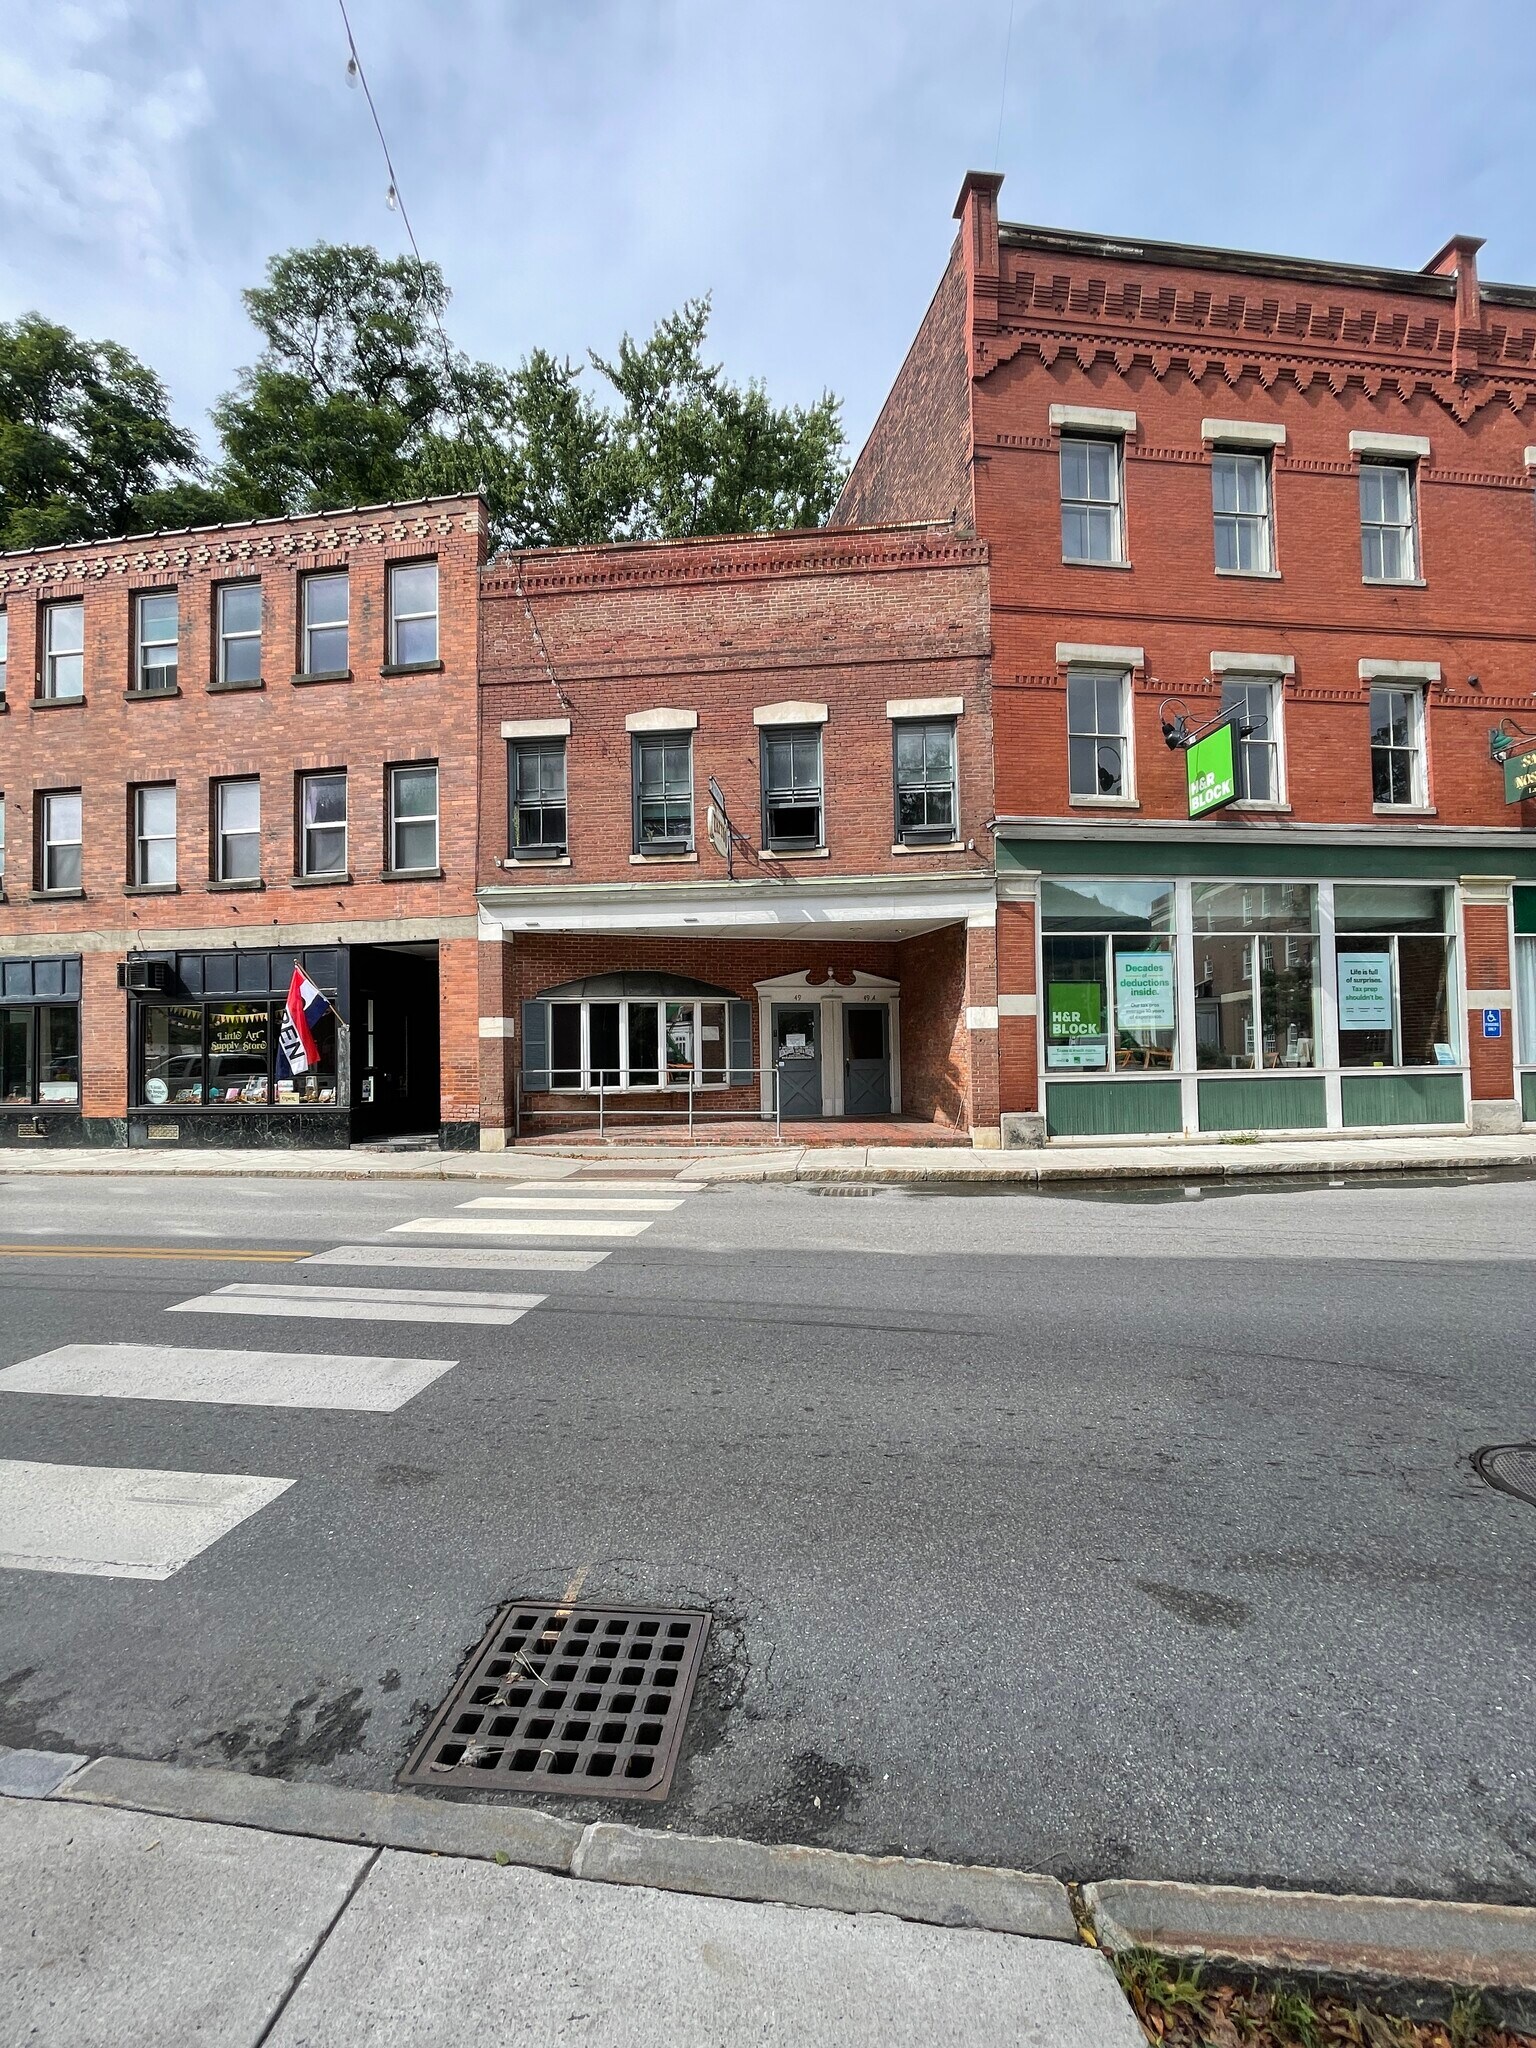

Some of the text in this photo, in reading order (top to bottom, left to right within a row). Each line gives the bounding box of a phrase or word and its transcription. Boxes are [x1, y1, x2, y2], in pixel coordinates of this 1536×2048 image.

[1191, 772, 1215, 796] H&R
[1192, 778, 1231, 810] BLOCK
[1125, 964, 1163, 972] Decades
[1120, 979, 1169, 987] deductions
[1131, 988, 1159, 996] inside.
[1052, 1011, 1081, 1022] H&R
[1052, 1023, 1098, 1034] BLOCK
[217, 1030, 265, 1041] Little Art
[211, 1041, 268, 1052] Supply Store
